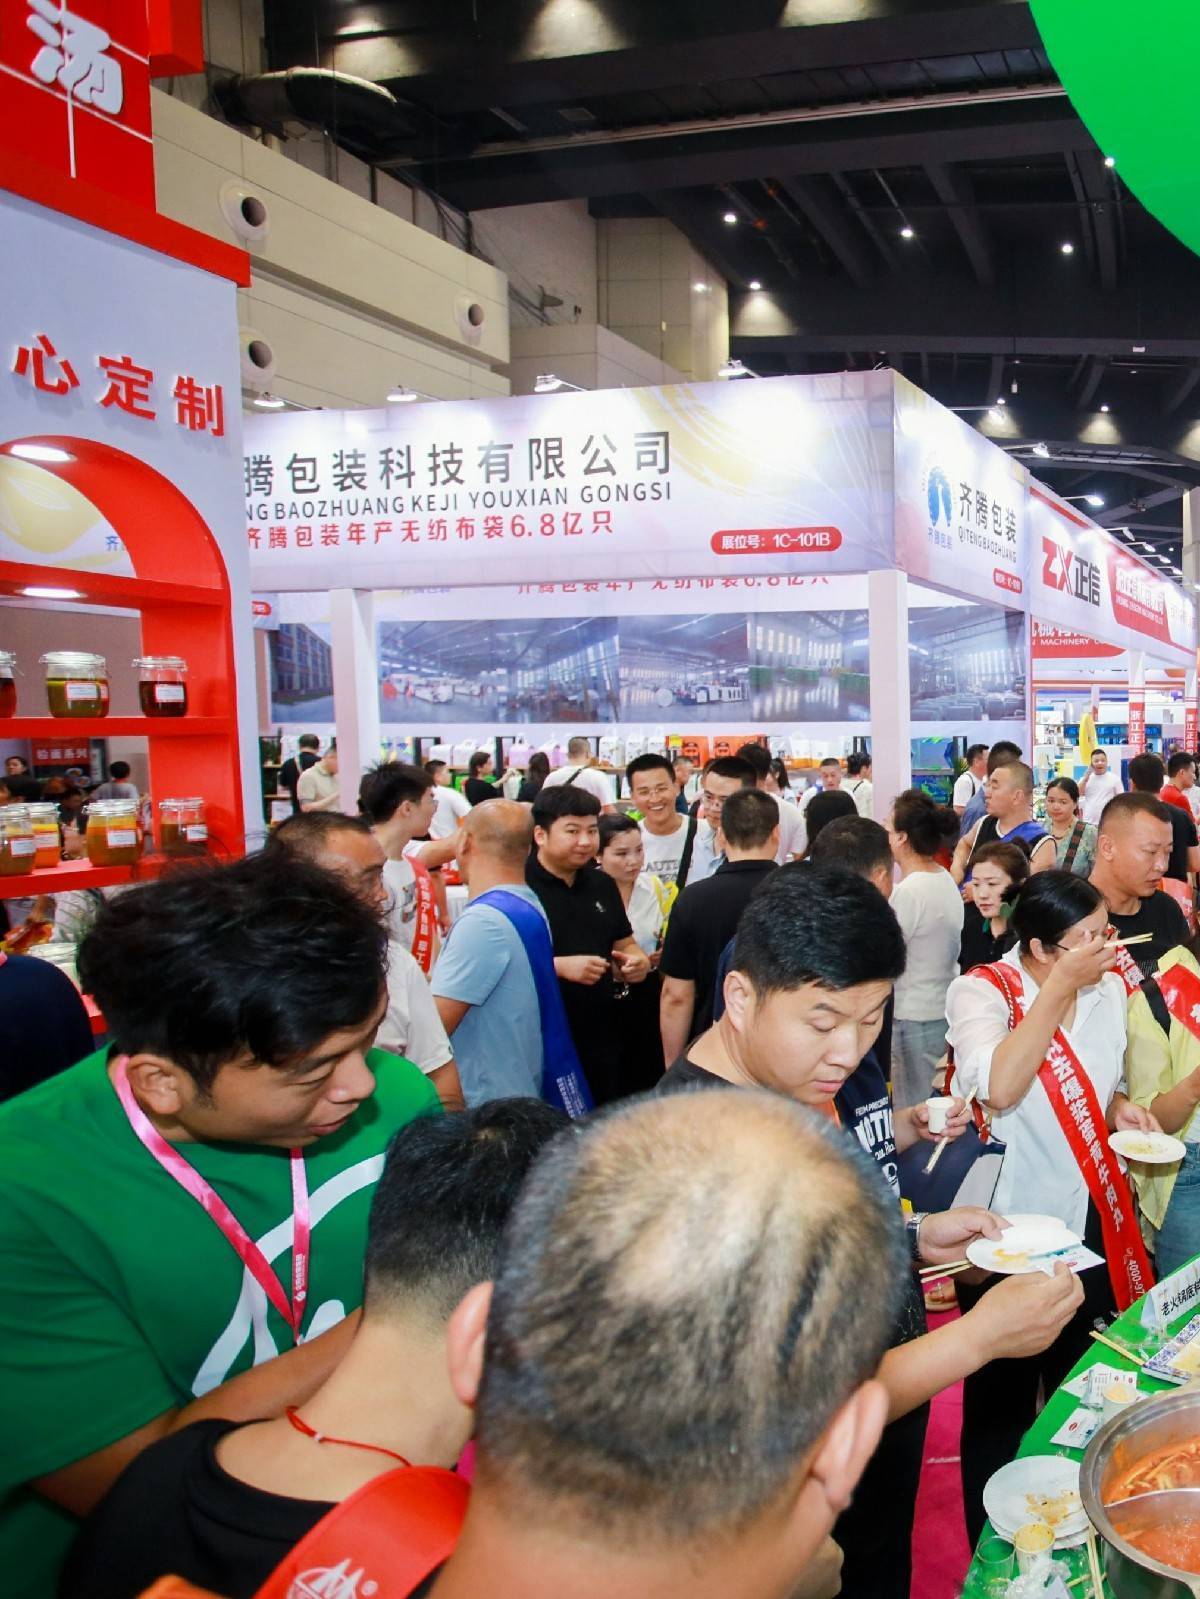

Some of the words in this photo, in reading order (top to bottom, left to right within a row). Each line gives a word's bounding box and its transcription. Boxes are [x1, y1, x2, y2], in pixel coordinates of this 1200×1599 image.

[27, 0, 124, 116] 汤
[11, 332, 225, 438] 心定制
[275, 495, 405, 521] BAOZHUANG
[411, 493, 458, 513] KEJI
[468, 487, 568, 510] YOUXIAN
[580, 481, 671, 503] GONGSI
[959, 481, 1016, 545] 齐腾包装
[1042, 536, 1073, 597] ZX
[1074, 555, 1101, 607] 正信
